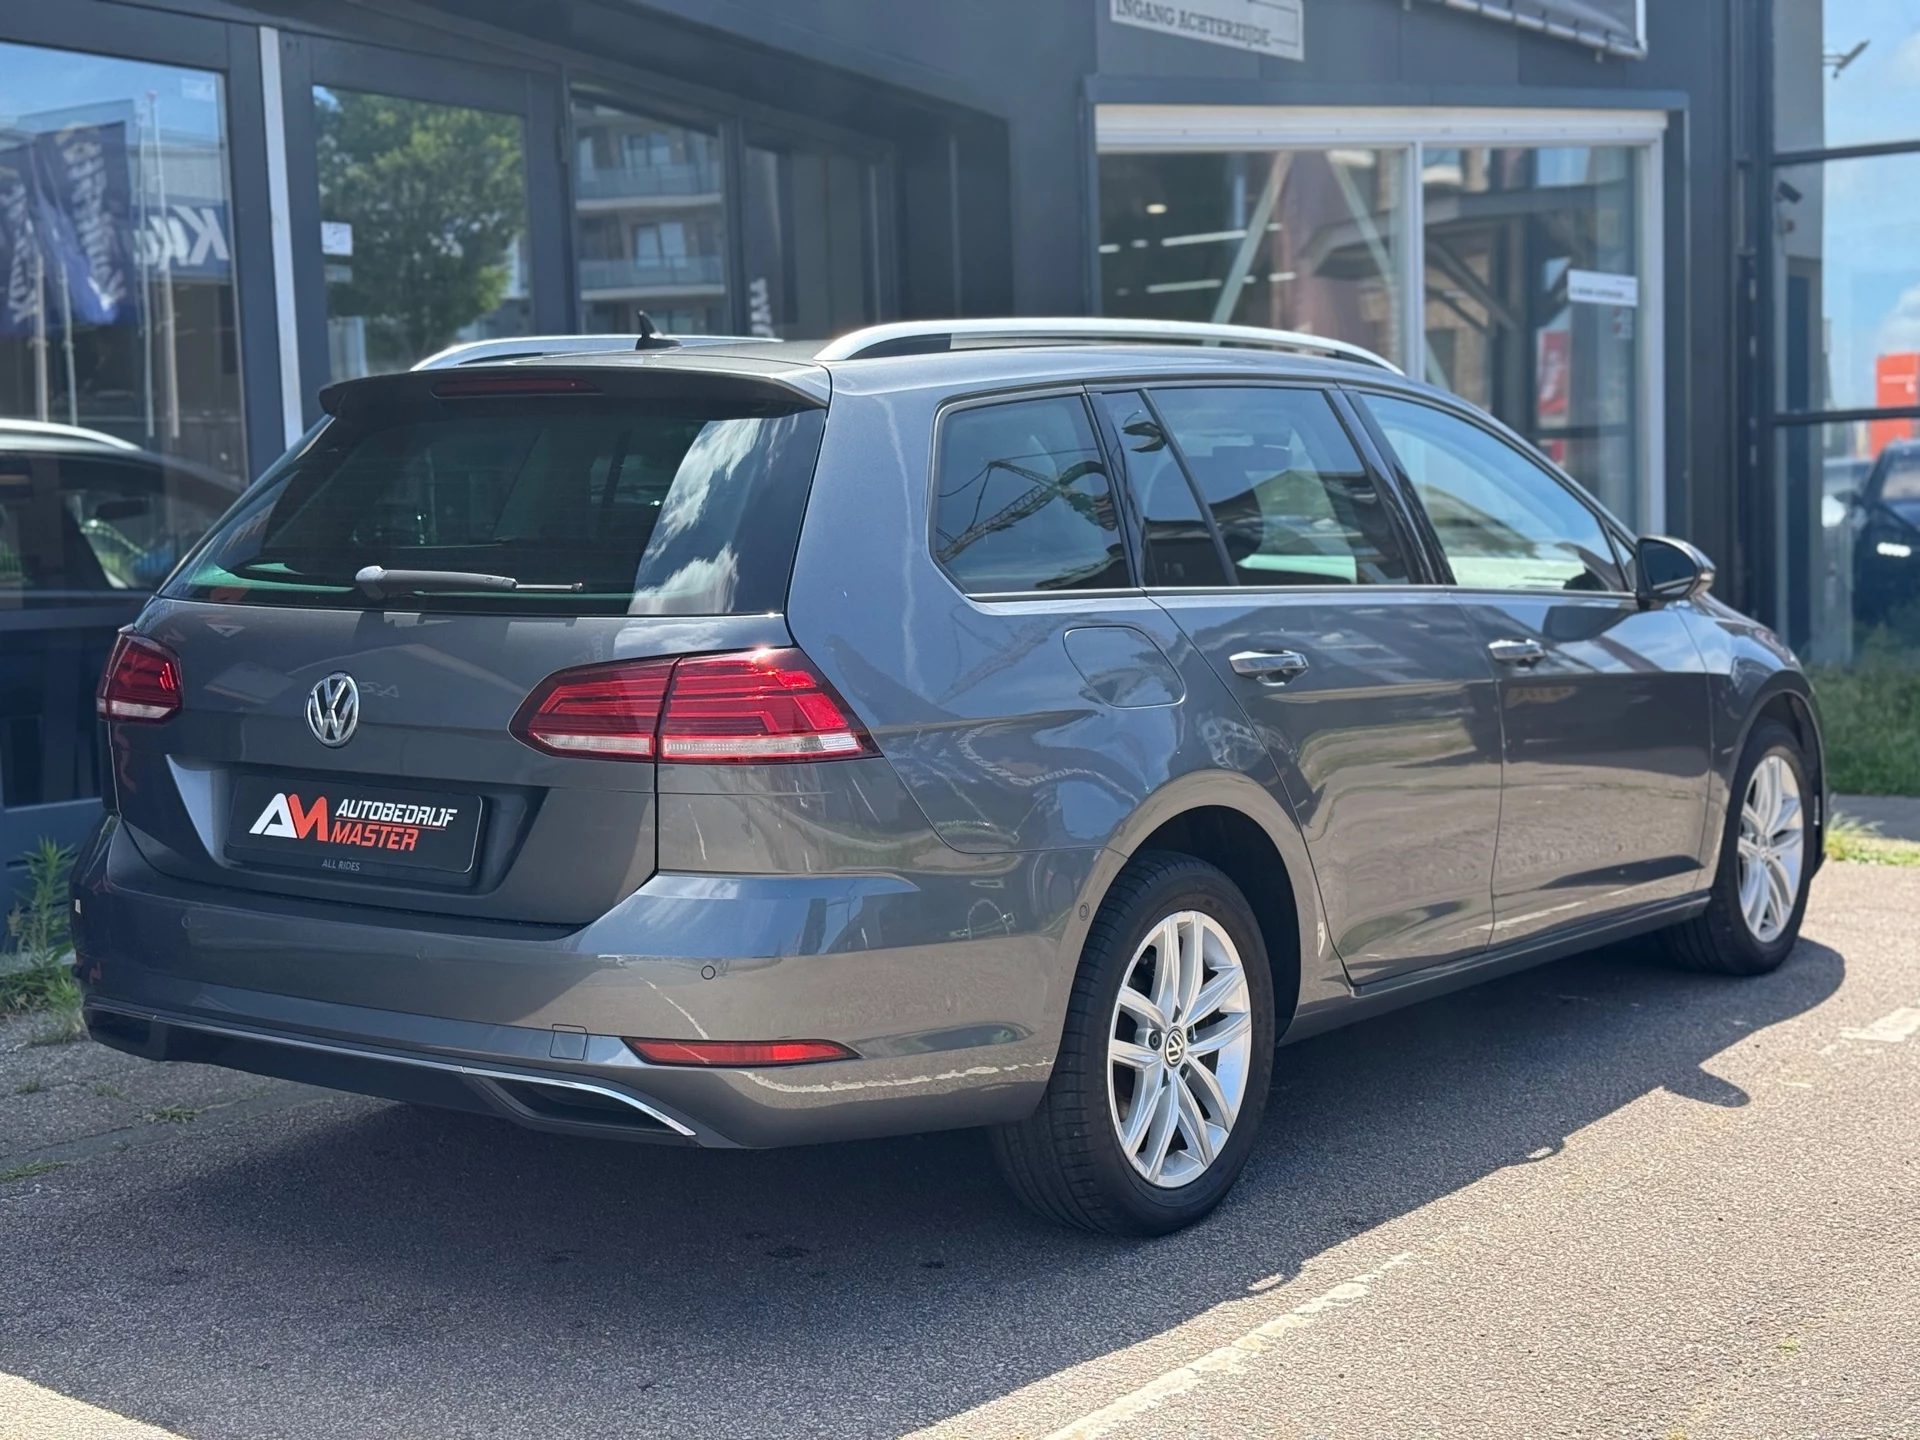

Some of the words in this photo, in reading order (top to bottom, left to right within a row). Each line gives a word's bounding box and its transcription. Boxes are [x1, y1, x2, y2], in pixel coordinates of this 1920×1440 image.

[1117, 0, 1175, 25] INGANG
[1179, 10, 1271, 46] ACHTERZIJDE
[335, 798, 458, 828] AUTOBEDRIJF
[329, 821, 419, 852] MASTER
[322, 858, 337, 869] ALL
[338, 860, 361, 872] RIDES
